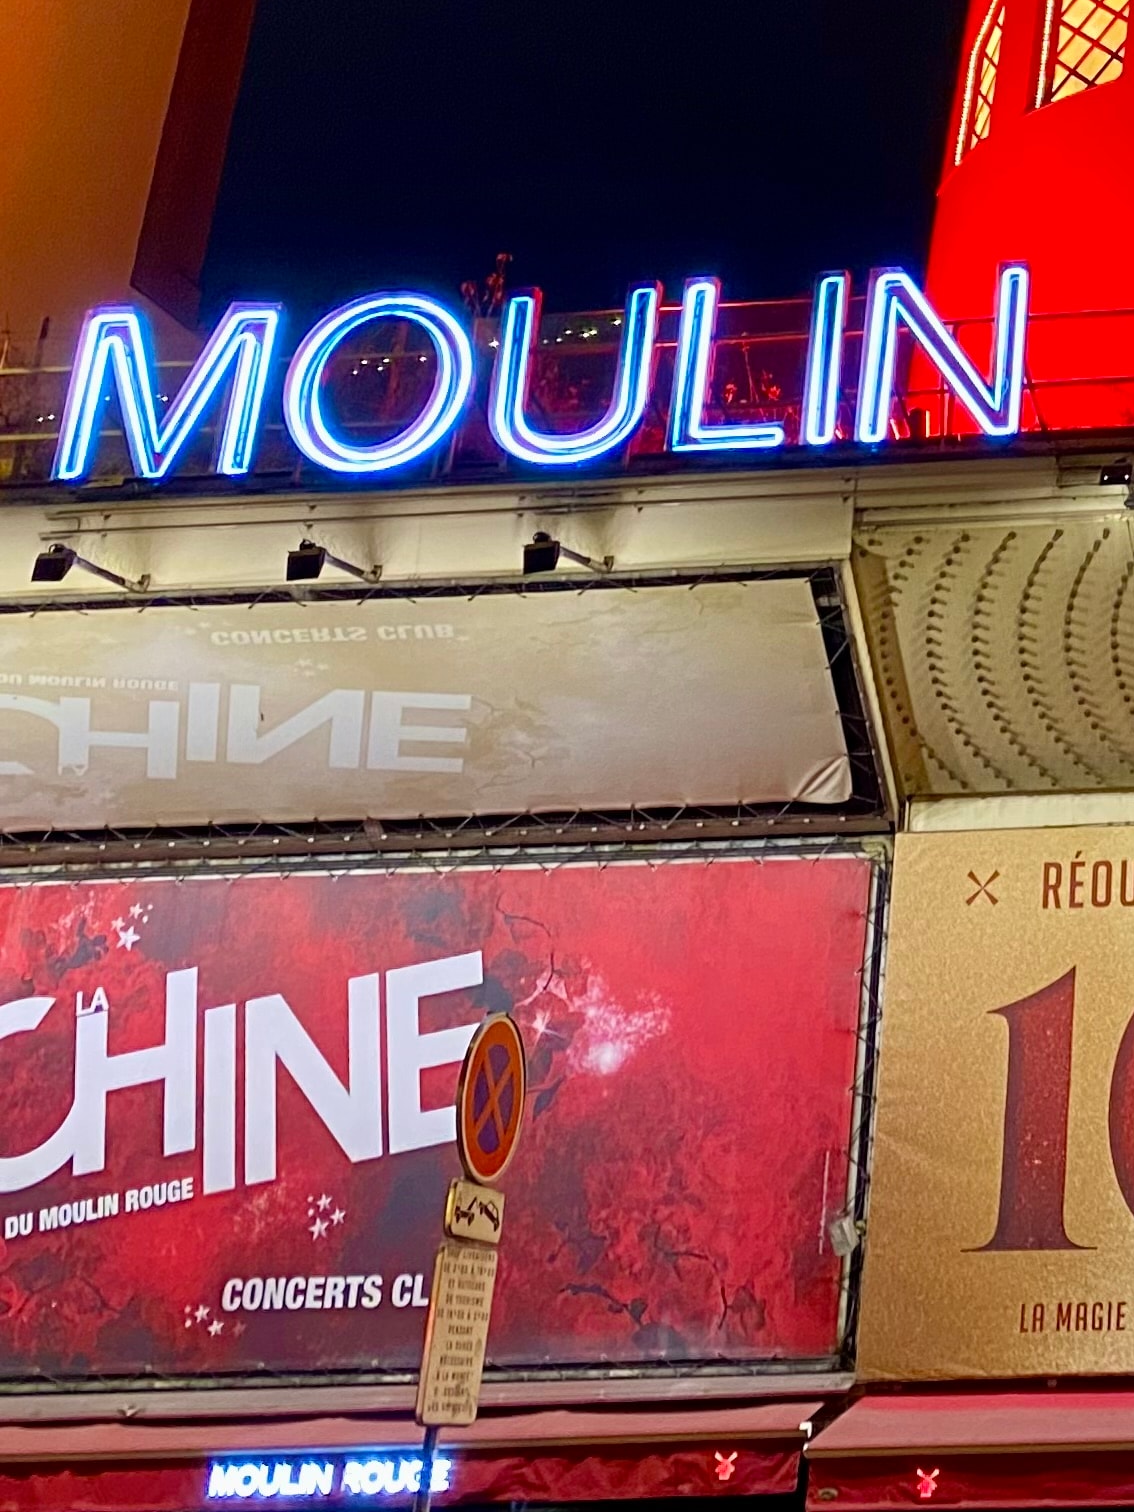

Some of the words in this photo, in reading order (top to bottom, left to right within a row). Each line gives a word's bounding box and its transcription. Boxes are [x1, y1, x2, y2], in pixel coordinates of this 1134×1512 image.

[50, 260, 1030, 480] MOULIN
[76, 986, 109, 1017] LA
[5, 1212, 33, 1239] DU
[39, 1193, 119, 1232] MOULIN
[125, 1177, 195, 1212] ROUGE
[222, 1274, 383, 1312] CONCERTS
[392, 1273, 430, 1309] CL
[1020, 1303, 1046, 1333] LA
[1055, 1301, 1127, 1332] MAGIE
[208, 1462, 334, 1498] MOULIN
